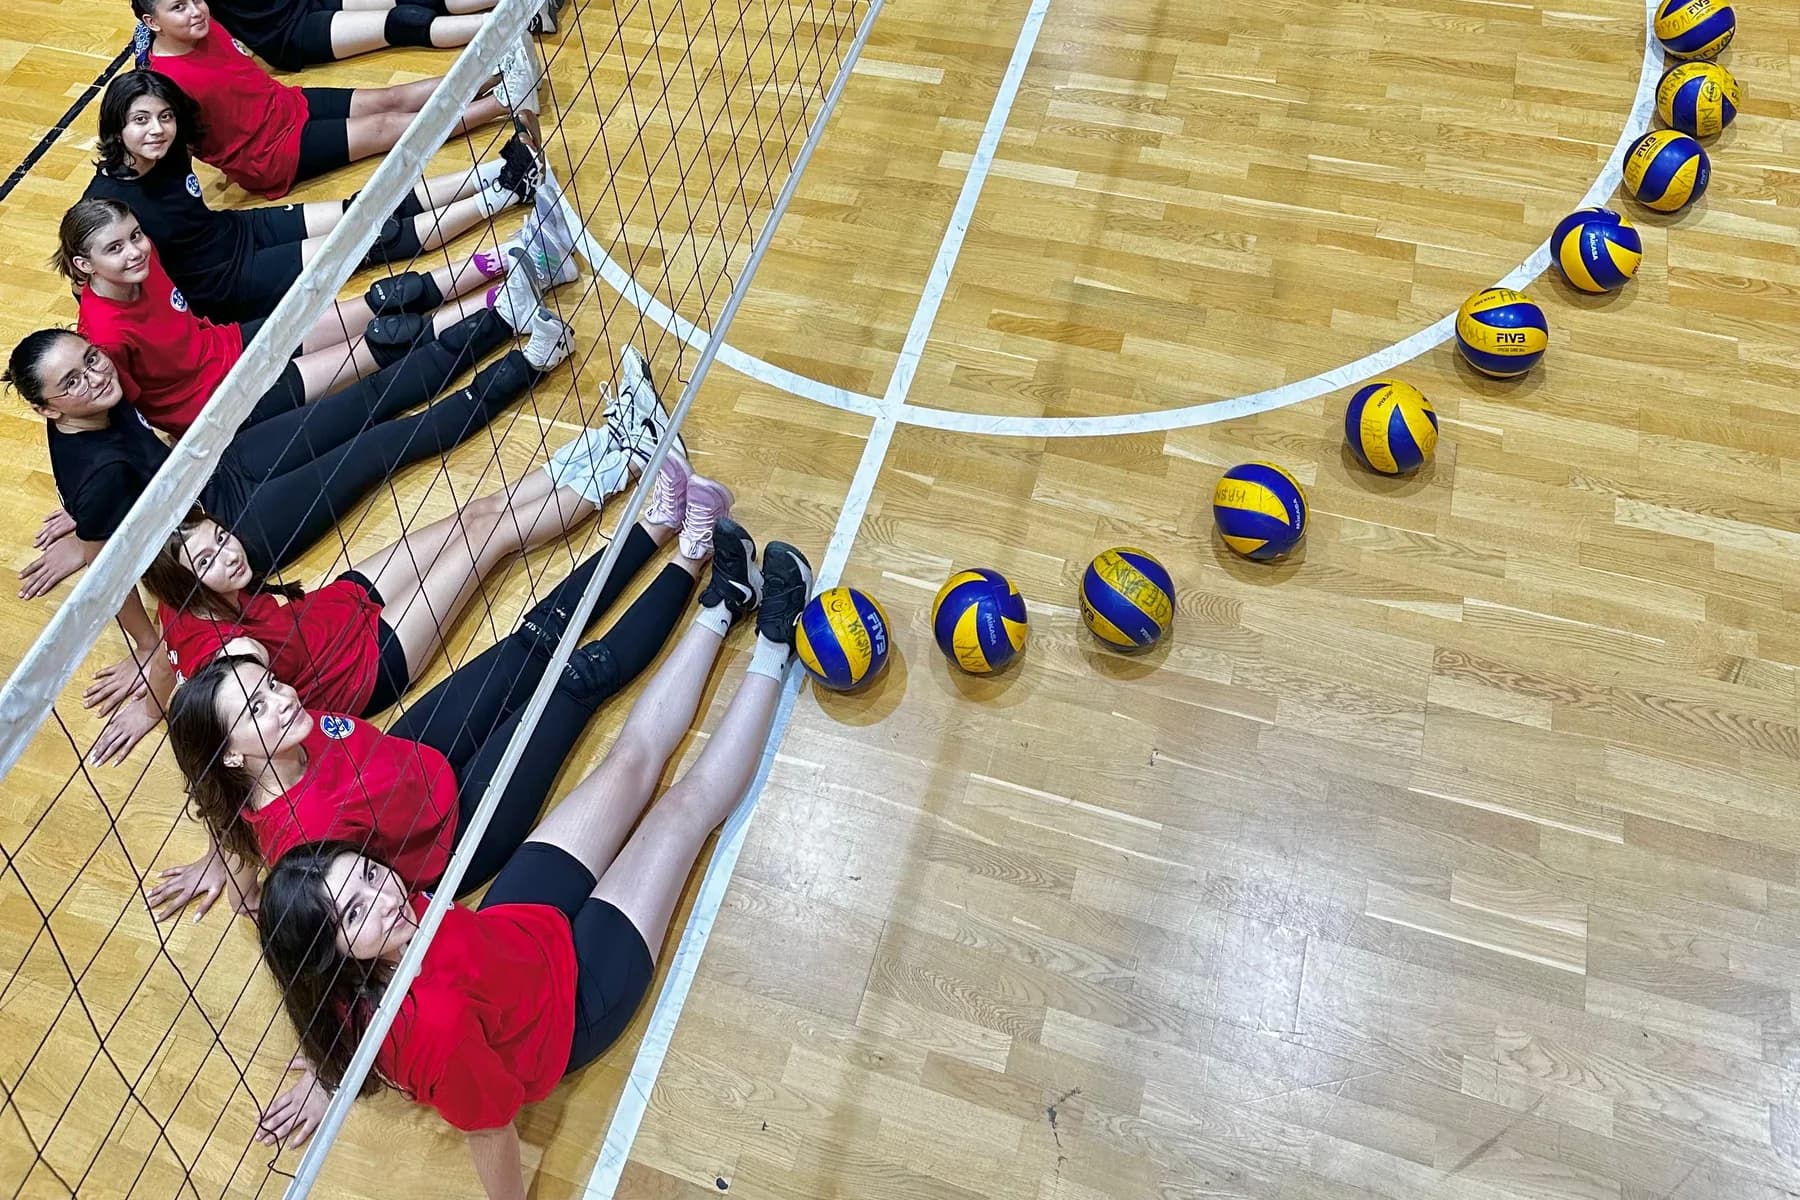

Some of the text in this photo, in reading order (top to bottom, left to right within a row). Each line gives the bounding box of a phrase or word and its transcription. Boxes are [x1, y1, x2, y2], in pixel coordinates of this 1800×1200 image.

[1635, 136, 1657, 158] FIVB
[1587, 232, 1599, 261] MIKASA
[1496, 332, 1526, 344] FIVB
[1292, 497, 1302, 530] MIKASA
[866, 611, 887, 656] FIVB
[984, 611, 997, 646] MIKASA
